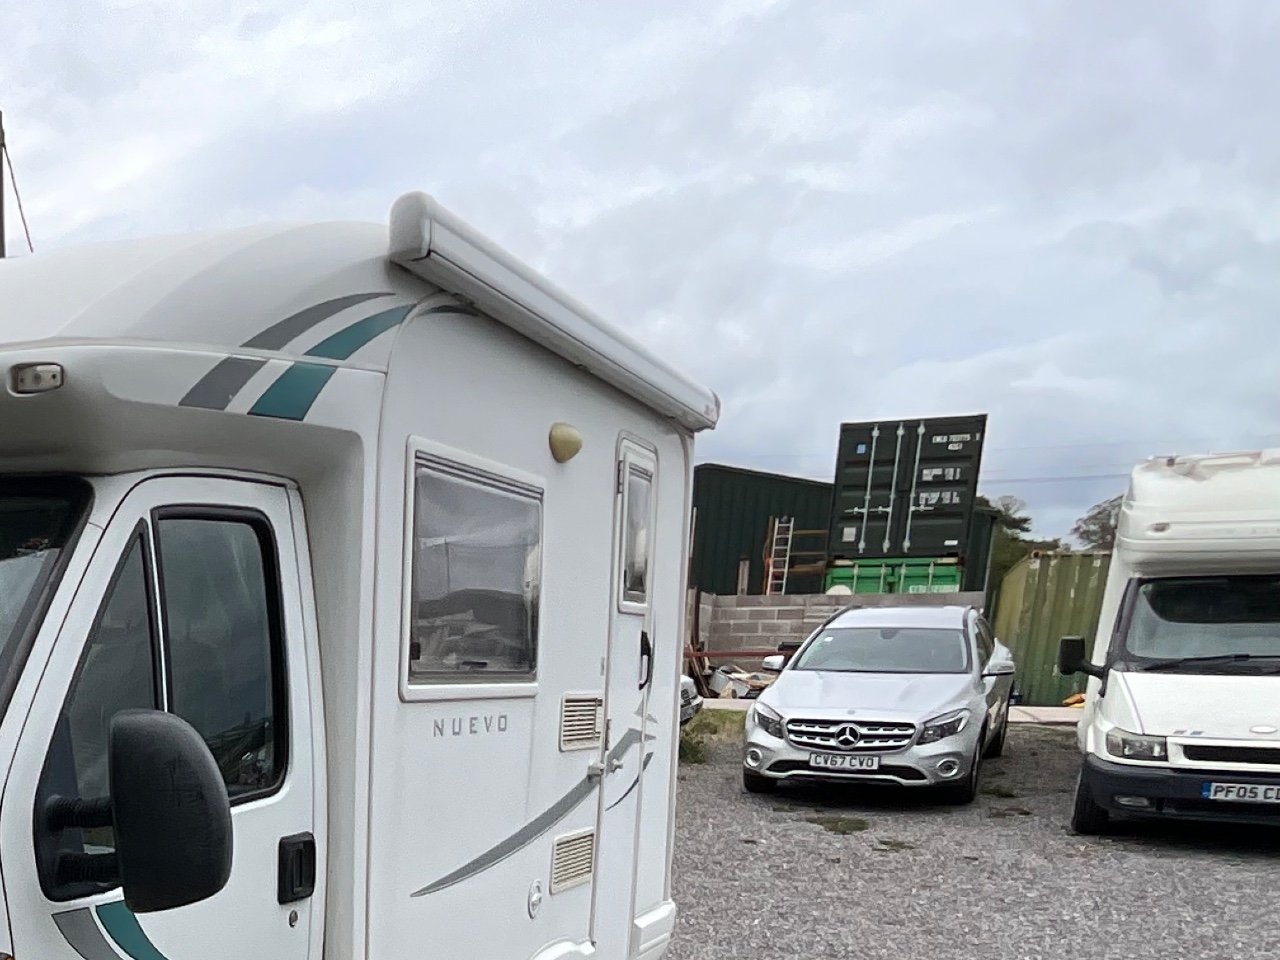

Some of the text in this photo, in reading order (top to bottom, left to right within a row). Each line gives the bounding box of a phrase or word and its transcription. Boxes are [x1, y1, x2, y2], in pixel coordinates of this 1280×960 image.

[433, 714, 507, 737] NUEVO
[814, 754, 846, 766] CV67
[1214, 785, 1259, 799] PF05
